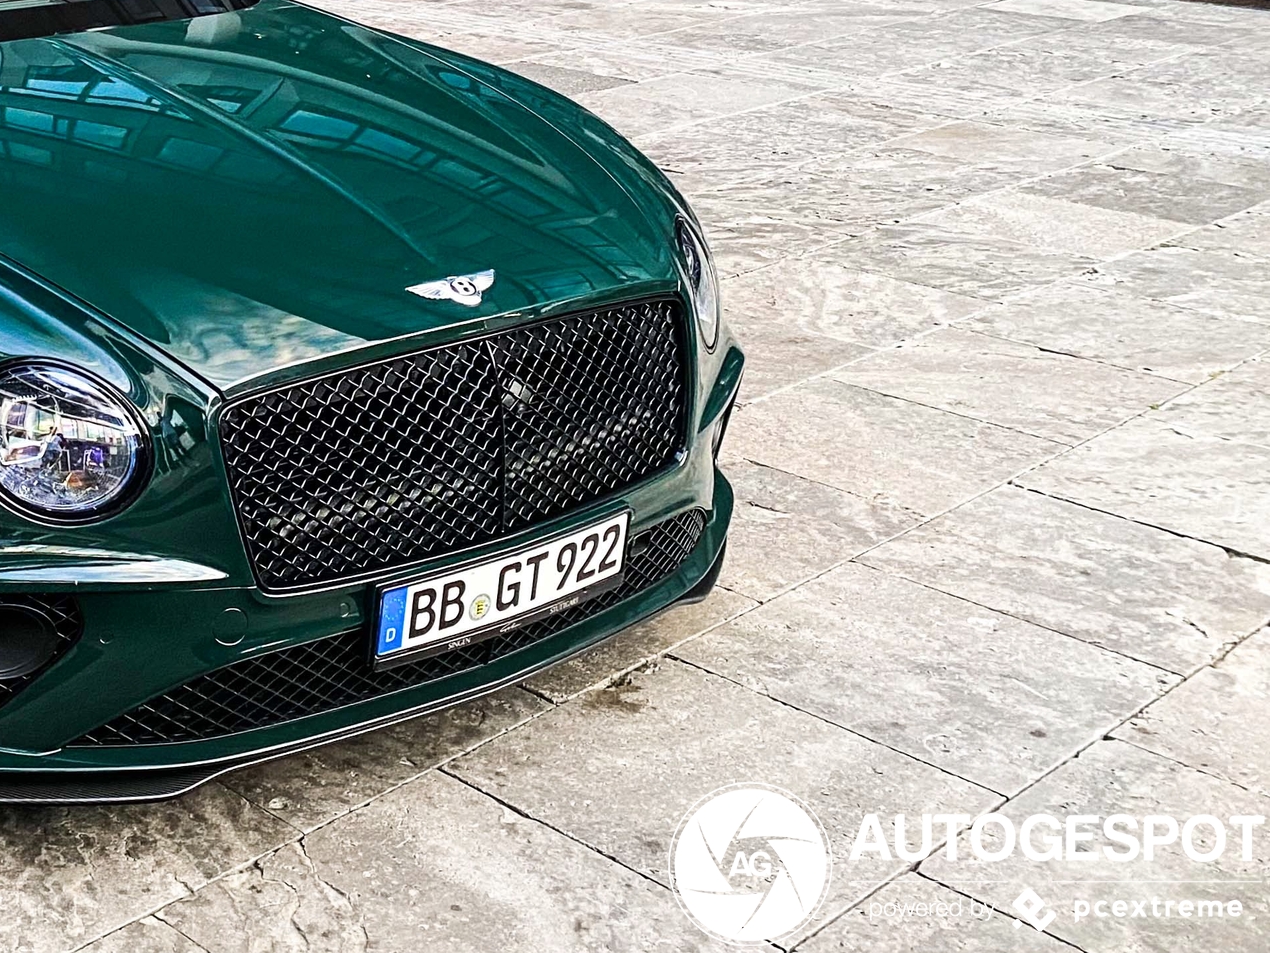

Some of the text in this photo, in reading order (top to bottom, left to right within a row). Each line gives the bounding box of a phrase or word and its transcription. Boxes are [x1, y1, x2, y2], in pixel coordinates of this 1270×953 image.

[408, 523, 622, 640] BB GT 922
[385, 627, 396, 643] D
